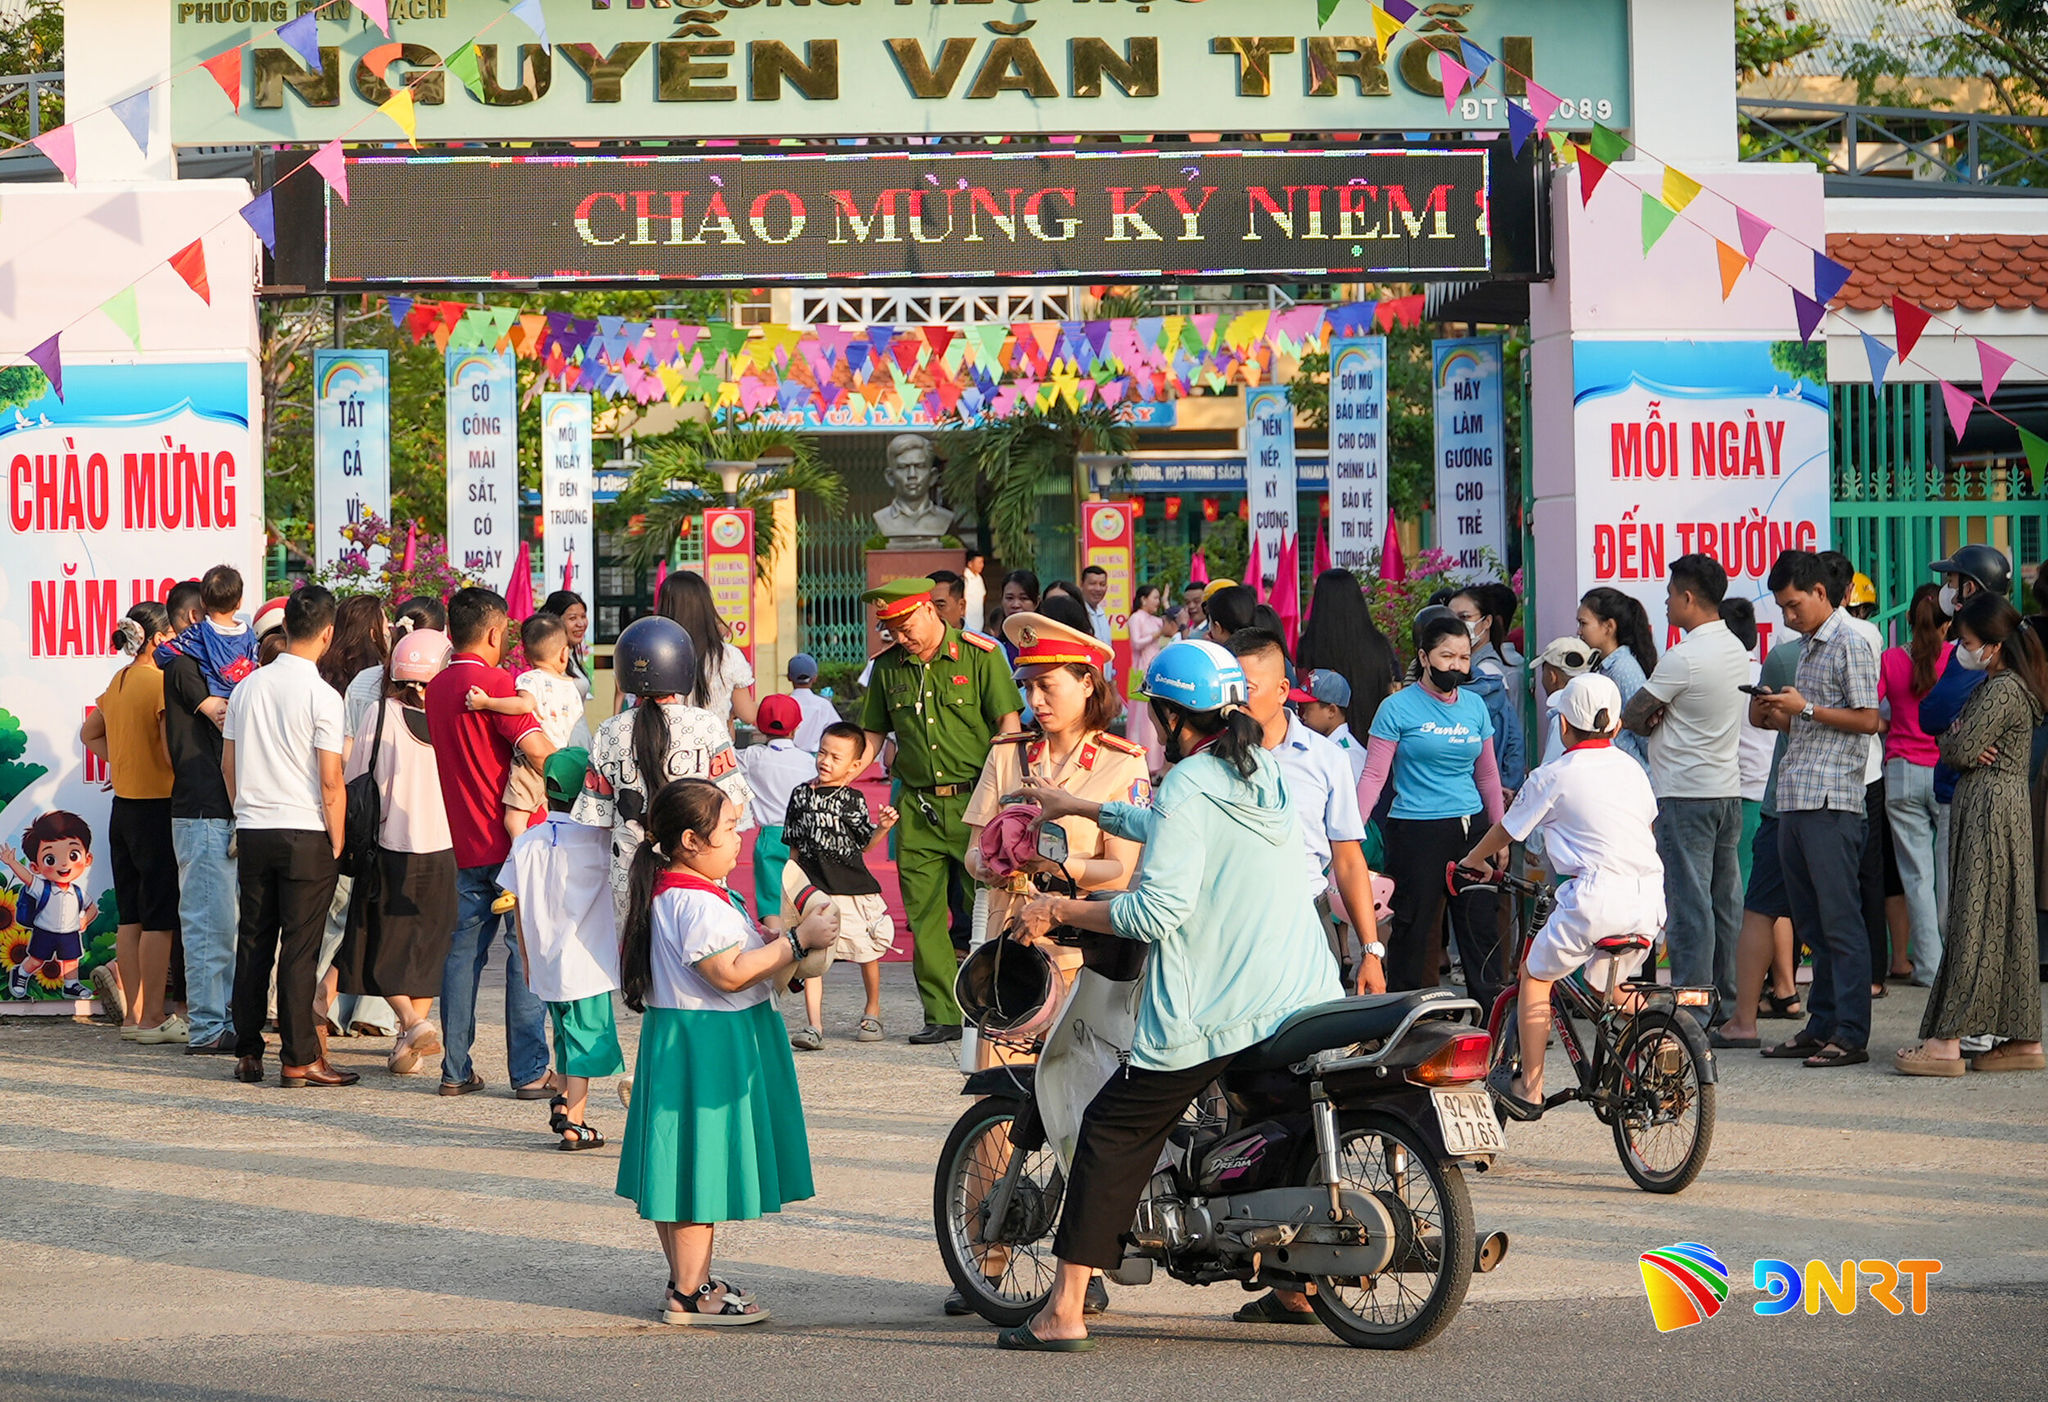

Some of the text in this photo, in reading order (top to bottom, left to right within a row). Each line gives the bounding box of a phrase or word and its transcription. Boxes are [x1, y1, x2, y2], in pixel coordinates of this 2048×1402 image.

[252, 3, 1534, 108] NGUYỄN VĂN TRỖI
[1461, 98, 1497, 121] ĐT
[574, 174, 806, 245] CHÀO
[827, 172, 1082, 244] MỪNG
[1104, 166, 1218, 241] KỶ
[1242, 178, 1456, 256] NIỆM
[472, 379, 490, 402] CÓ
[1341, 370, 1356, 394] ĐỘI
[1454, 377, 1481, 401] HÃY
[339, 391, 365, 428] TẤT
[1336, 395, 1379, 420] BẢO HIỂM
[462, 412, 501, 435] CÔNG
[1453, 411, 1483, 435] LÀM
[1338, 432, 1376, 449] CHO CON
[1611, 400, 1786, 478] MỖI NGÀY
[343, 440, 363, 476] CẢ
[469, 446, 495, 468] MÀI
[556, 450, 581, 469] NGÀY
[1337, 459, 1364, 478] CHÍNH
[1366, 459, 1377, 478] LÀ
[1445, 447, 1493, 469] GƯƠNG
[9, 435, 238, 533] CHÀO MỪNG
[469, 475, 497, 504] SẮT,
[559, 478, 578, 497] ĐẾN
[1456, 482, 1483, 502] CHO
[1342, 486, 1373, 512] BẢO VỆ
[474, 512, 492, 535] CÓ
[551, 506, 588, 525] TRƯỜNG
[1256, 509, 1289, 529] CƯƠNG
[1458, 508, 1483, 535] TRẺ
[1341, 517, 1373, 542] TRÍ TUỆ
[1594, 504, 1665, 579] ĐẾN
[563, 533, 575, 552] LÀ
[30, 562, 118, 657] NĂM
